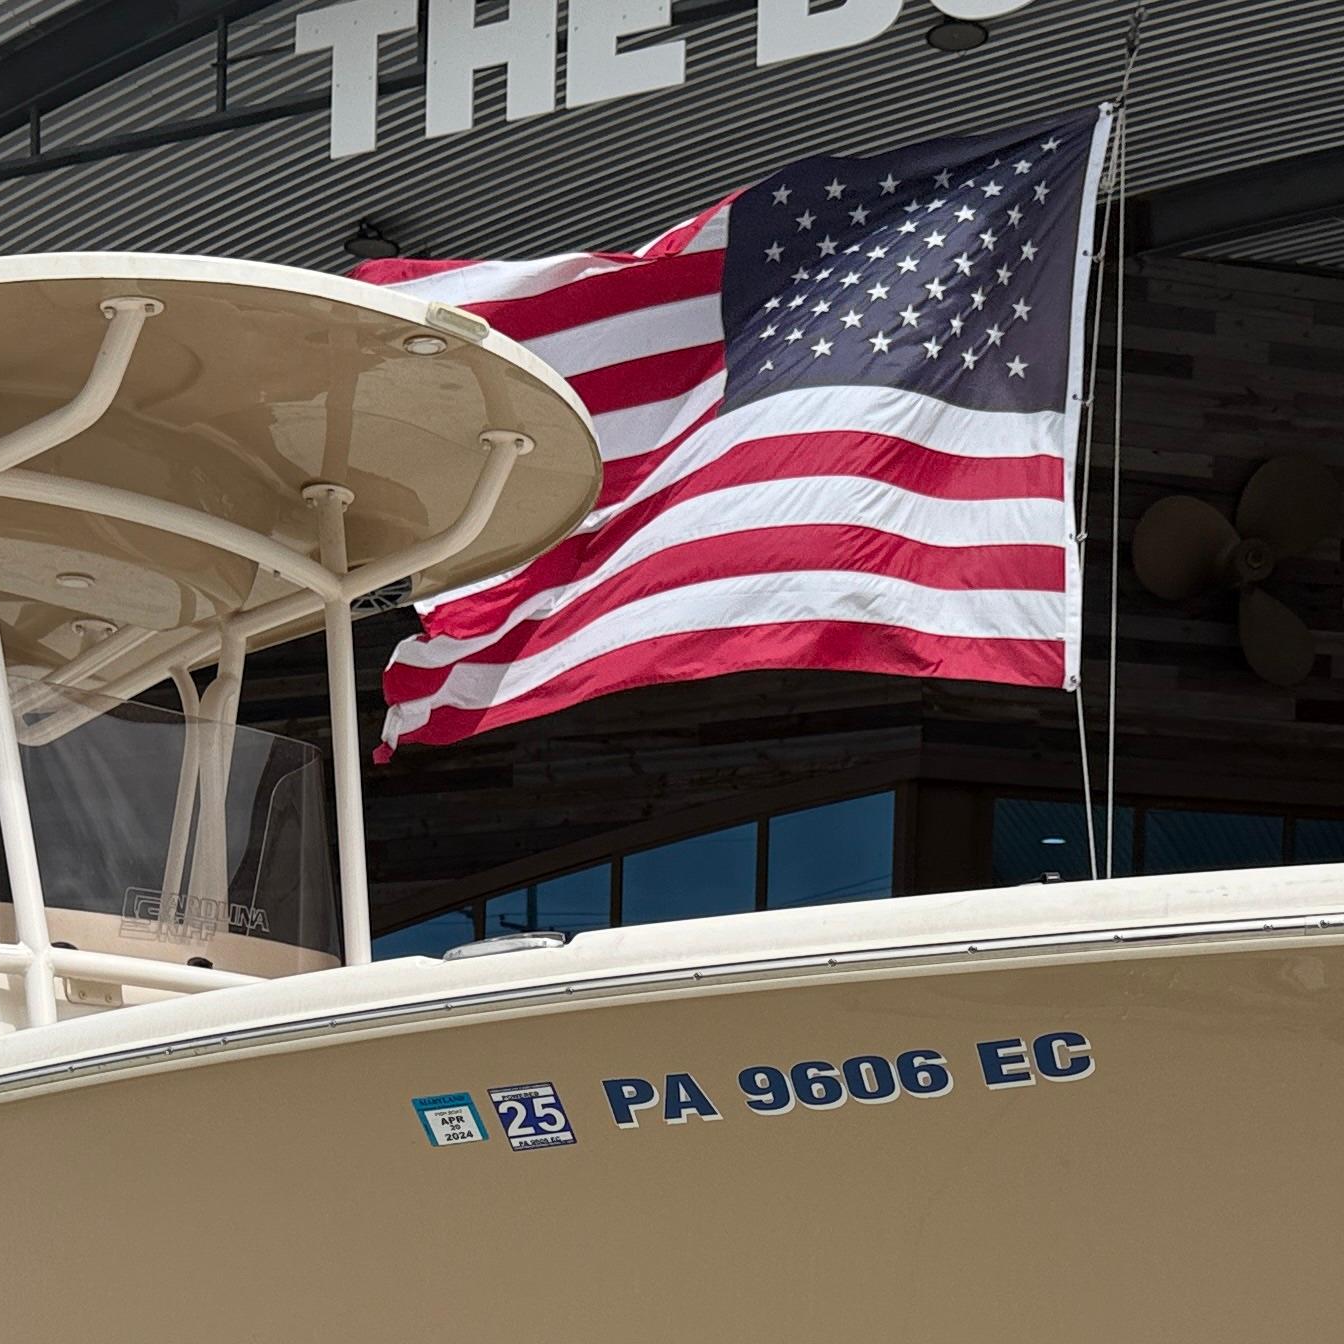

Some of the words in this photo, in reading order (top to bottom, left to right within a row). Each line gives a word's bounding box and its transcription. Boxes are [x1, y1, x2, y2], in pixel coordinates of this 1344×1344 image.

[294, 0, 686, 160] THE
[601, 1071, 723, 1129] PA
[737, 1048, 954, 1116] 9606
[976, 1031, 1096, 1090] EC
[441, 1115, 465, 1126] APR
[444, 1129, 474, 1142] 2024
[498, 1095, 566, 1138] 25
